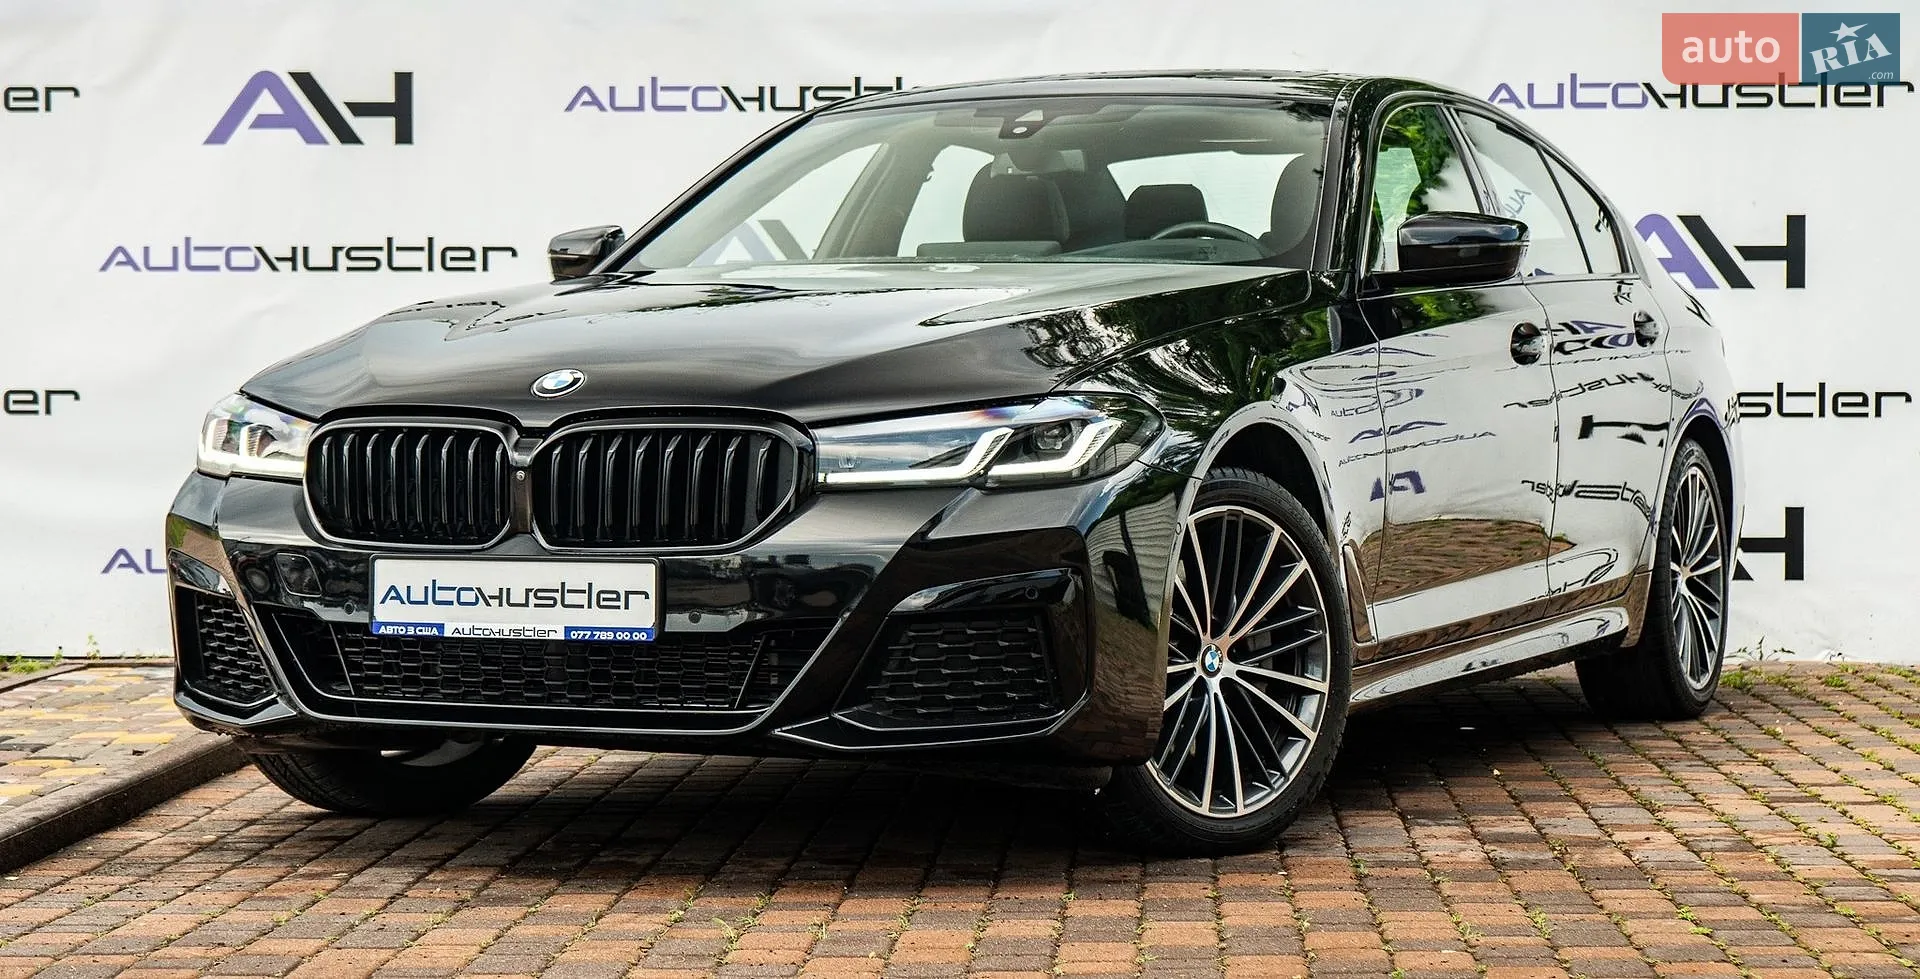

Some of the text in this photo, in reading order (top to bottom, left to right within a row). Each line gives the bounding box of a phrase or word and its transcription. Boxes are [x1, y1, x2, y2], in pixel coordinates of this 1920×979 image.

[203, 70, 415, 146] AH
[379, 578, 650, 611] AutoHustler
[378, 625, 406, 635] АВТО
[416, 627, 439, 636] США
[570, 631, 647, 641] 077 789 00 00
